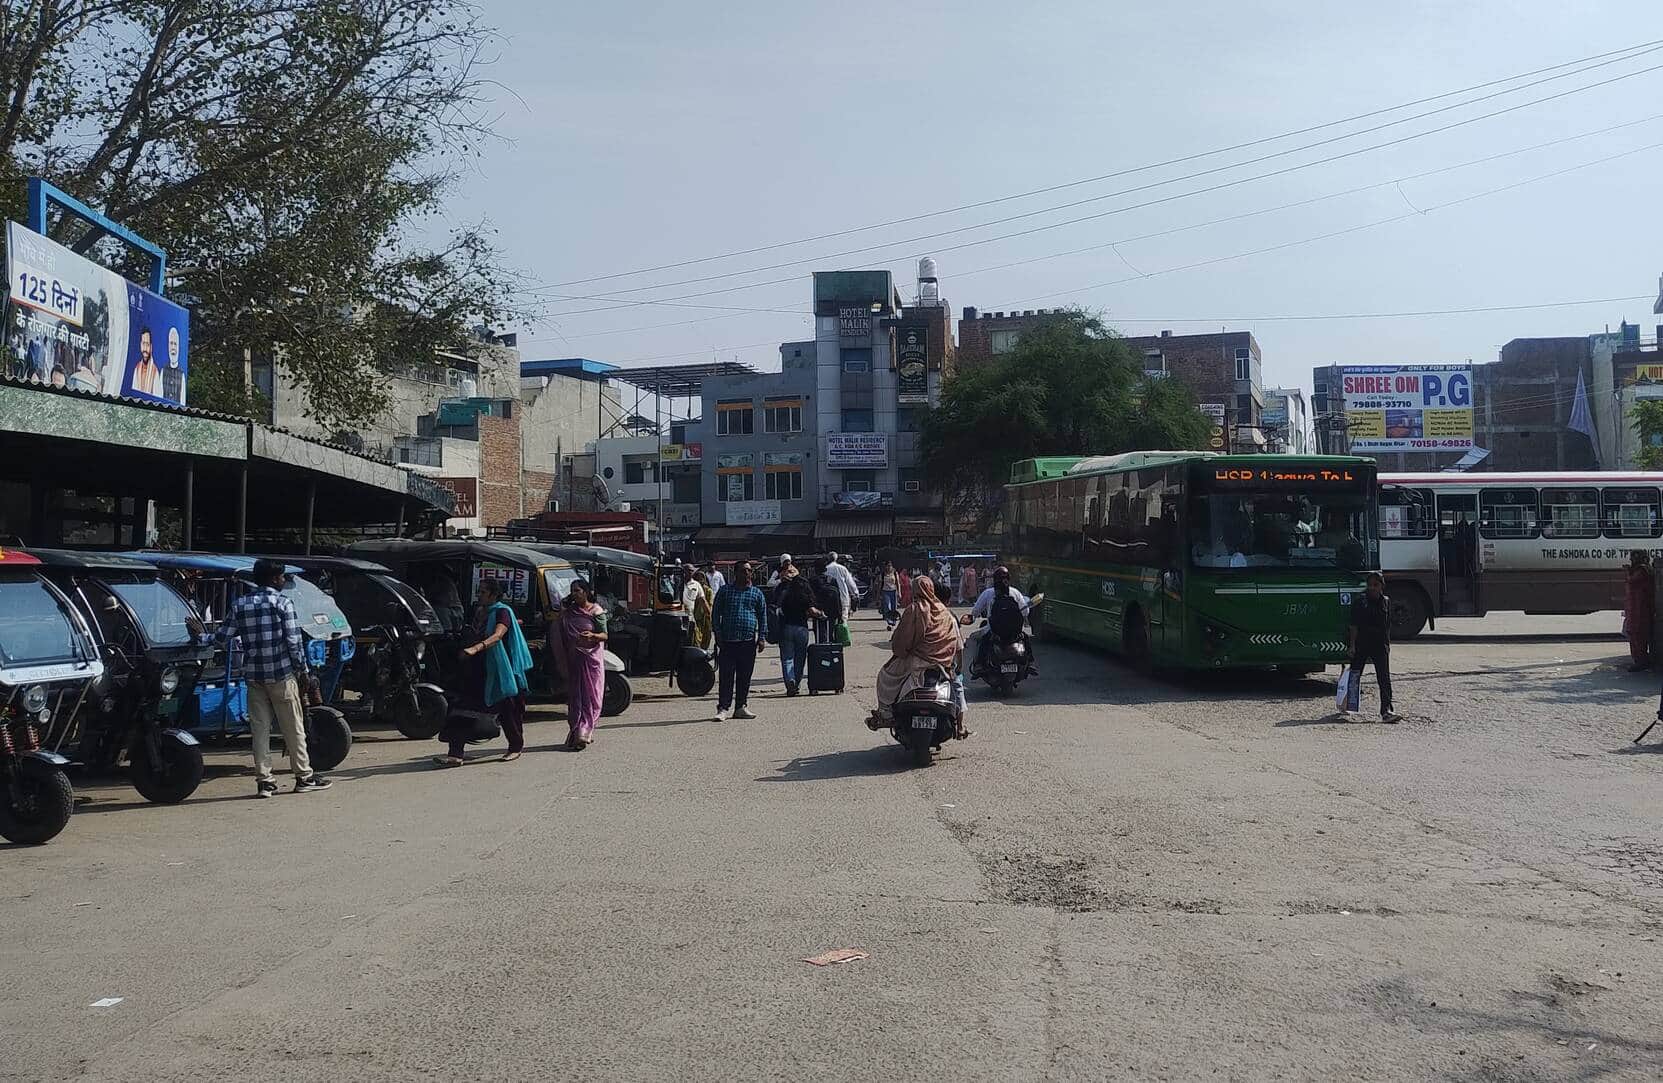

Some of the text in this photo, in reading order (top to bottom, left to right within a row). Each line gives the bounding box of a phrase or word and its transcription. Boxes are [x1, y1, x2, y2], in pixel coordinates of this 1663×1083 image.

[20, 272, 78, 316] 125 दिनों
[839, 308, 868, 318] HOTEL
[16, 308, 26, 328] के
[56, 324, 69, 343] की
[840, 319, 869, 329] MALIK
[1344, 373, 1470, 407] SHREE OM P.G
[1542, 549, 1557, 559] THE
[1558, 549, 1590, 559] ASHOKA
[479, 568, 525, 579] IELTS
